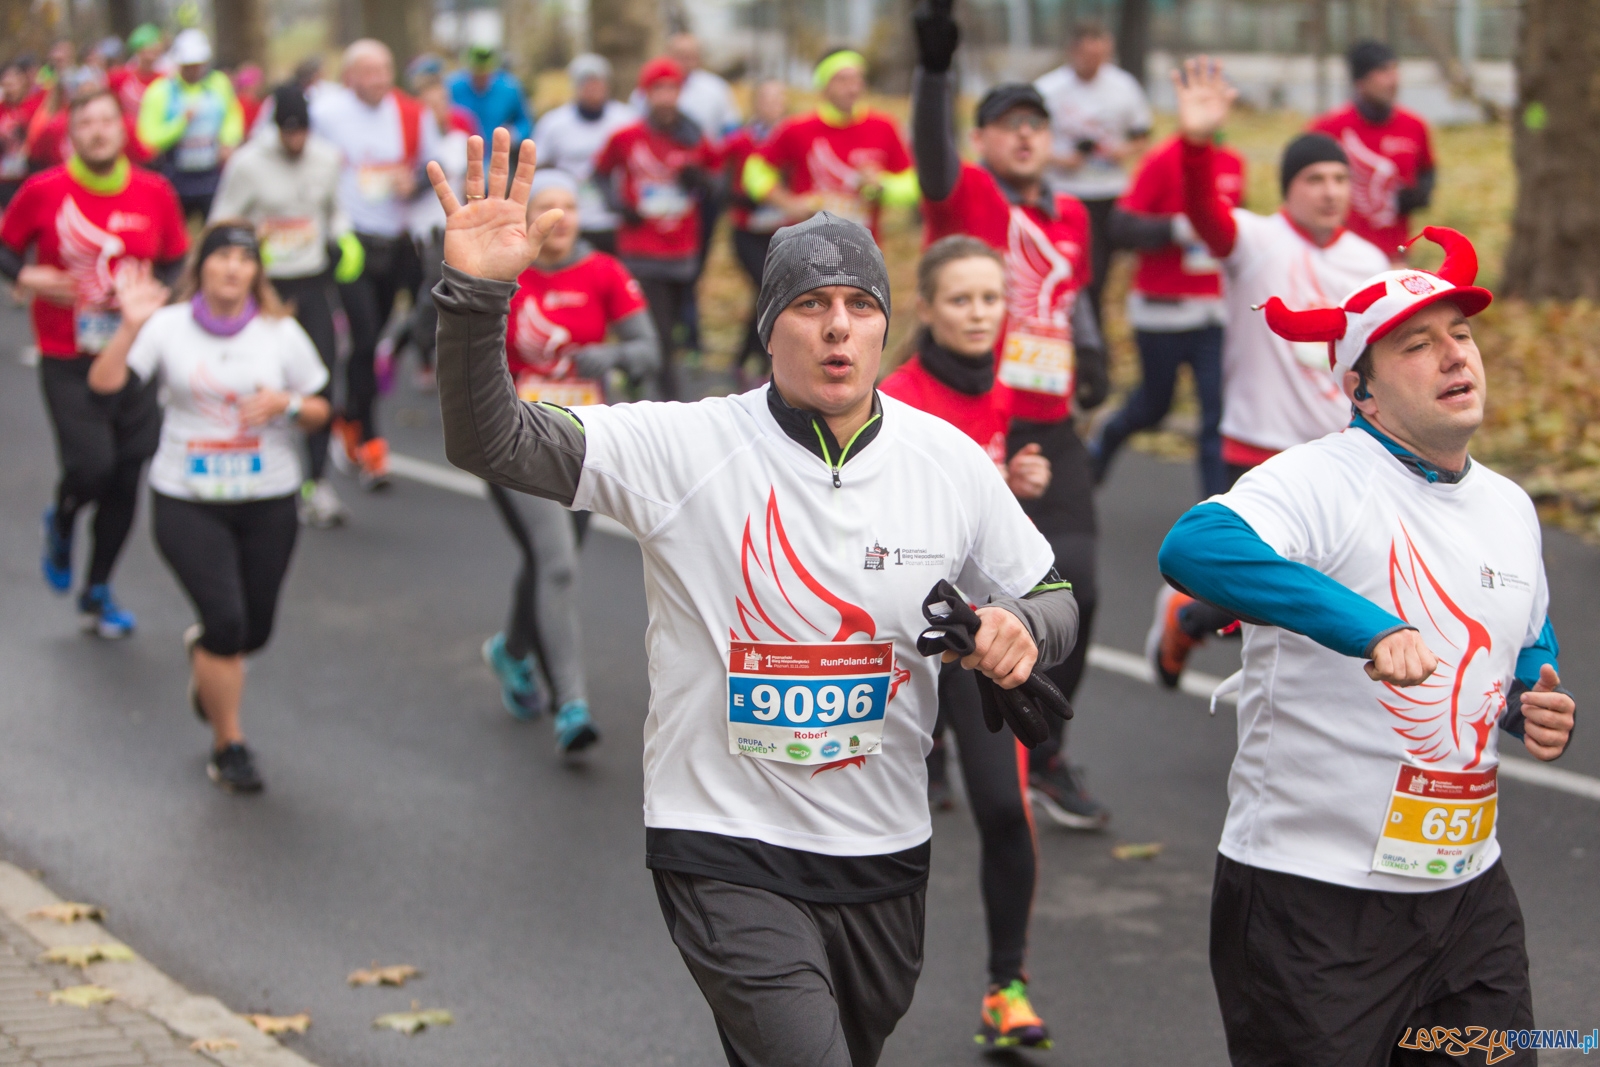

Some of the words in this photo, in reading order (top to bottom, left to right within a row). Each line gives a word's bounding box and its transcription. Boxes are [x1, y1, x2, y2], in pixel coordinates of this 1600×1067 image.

[894, 548, 903, 565] 1
[765, 655, 773, 668] 1
[820, 656, 883, 667] RunPoland.org
[733, 693, 745, 707] E
[751, 683, 874, 723] 9096
[794, 730, 828, 740] Robert
[737, 737, 763, 747] GRUPA
[738, 744, 768, 754] LUXMED
[1390, 811, 1403, 824] D
[1421, 806, 1485, 843] 651
[1436, 848, 1463, 857] Marcin
[1382, 853, 1406, 864] GRUPA
[1381, 860, 1409, 871] LUXMED
